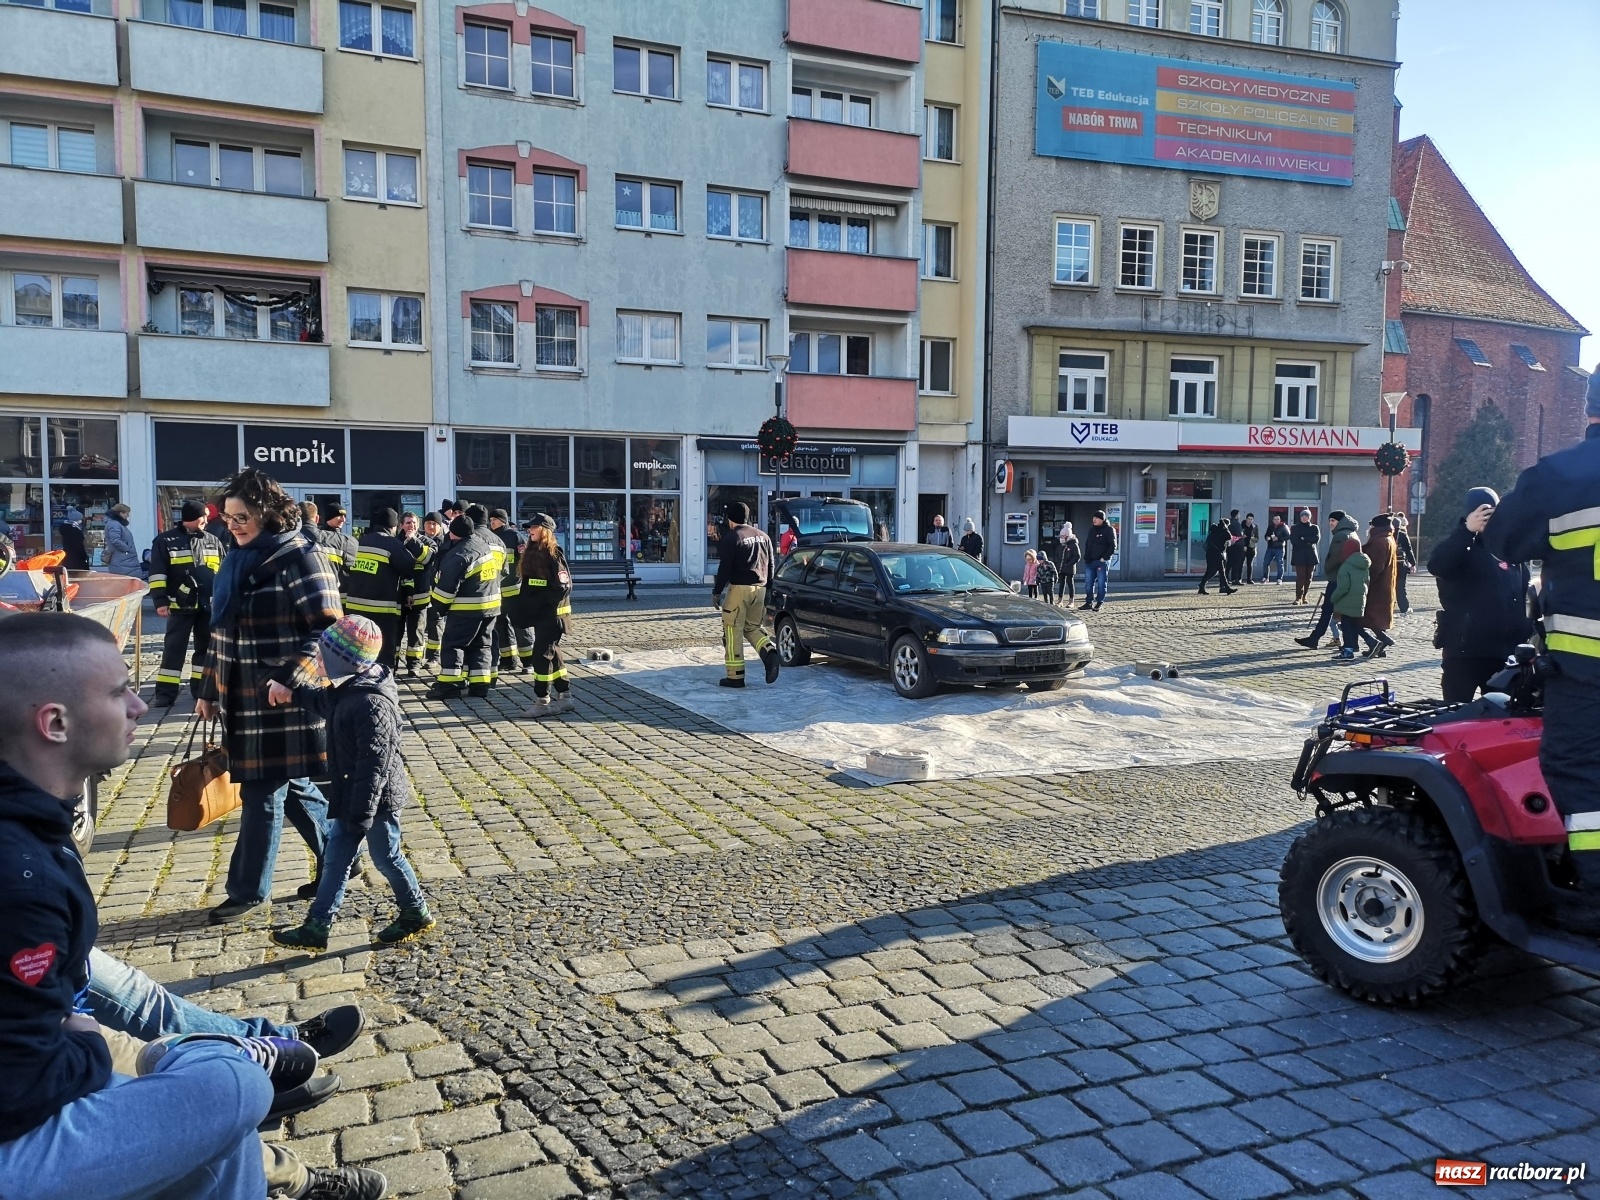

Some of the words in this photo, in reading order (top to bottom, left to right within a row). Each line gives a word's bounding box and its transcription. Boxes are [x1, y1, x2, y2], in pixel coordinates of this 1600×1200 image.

[1071, 86, 1095, 99] TEB
[1097, 90, 1149, 105] Edukacja
[1178, 74, 1240, 92] SZKOŁY
[1243, 83, 1330, 104] MEDYCZNE
[1068, 111, 1105, 127] NABÓR
[1108, 115, 1138, 129] TRWA
[1177, 98, 1239, 116] SZKOŁY
[1243, 106, 1339, 128] POLICEALNE
[1177, 121, 1272, 142] TECHNIKUM
[1175, 146, 1262, 165] AKADEMIA
[1278, 156, 1330, 172] WIEKU
[1093, 423, 1119, 435] TEB
[1248, 426, 1360, 447] ROSSMANN
[254, 440, 335, 467] empik
[769, 454, 845, 472] gelatopiu
[633, 459, 677, 470] empik.com
